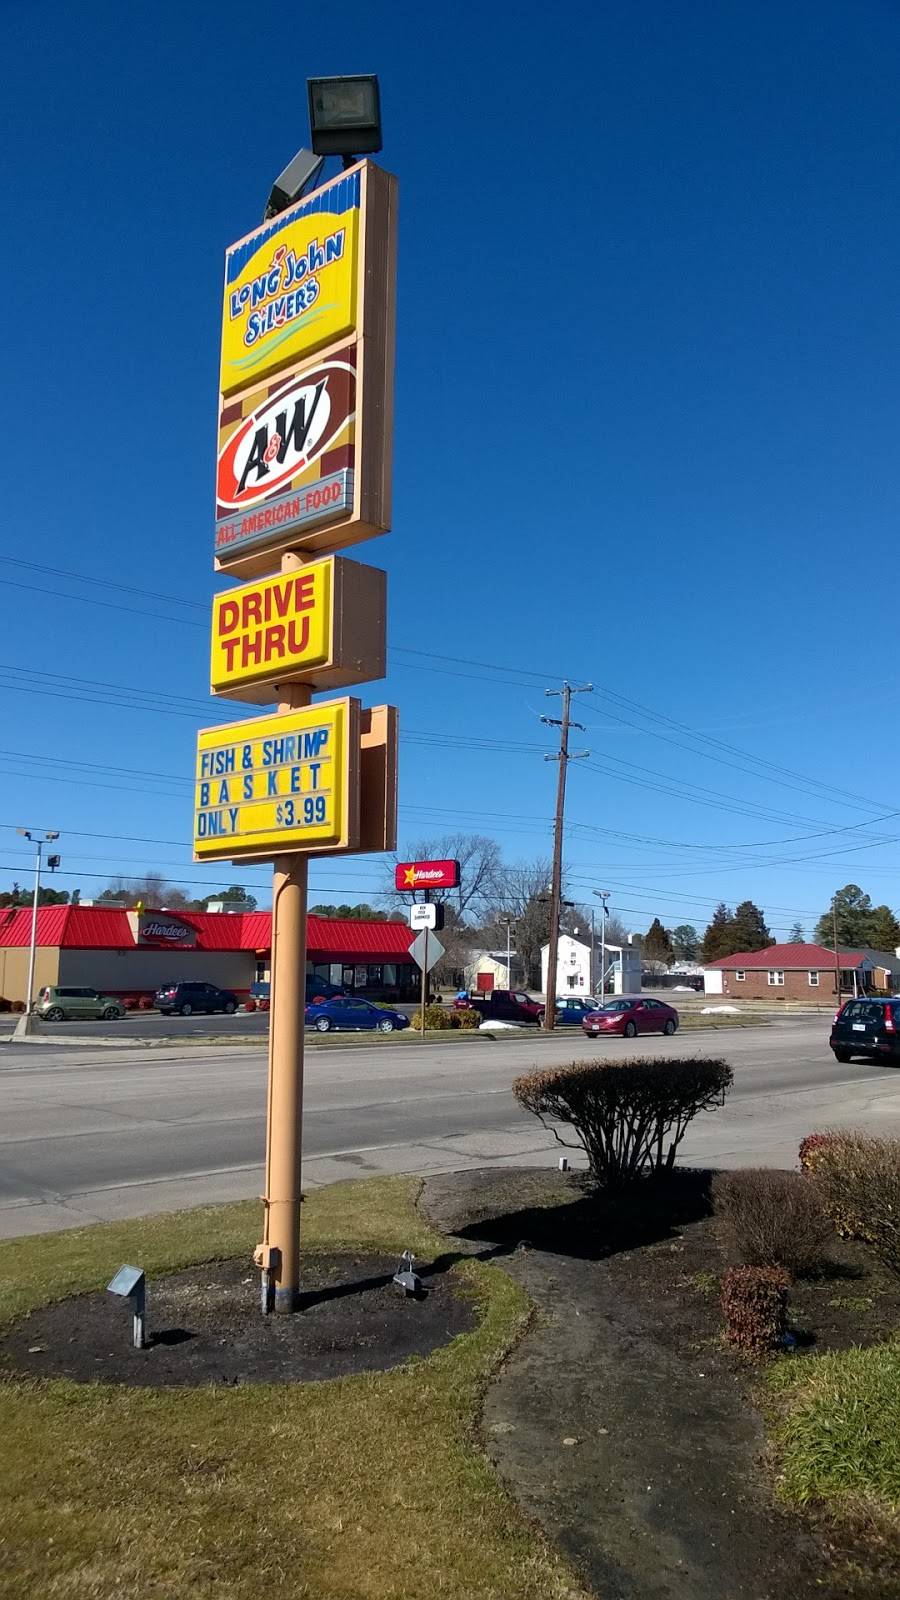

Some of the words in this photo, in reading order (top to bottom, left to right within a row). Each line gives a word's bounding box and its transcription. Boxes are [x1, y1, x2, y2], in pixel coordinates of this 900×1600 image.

[234, 375, 329, 498] A&W
[217, 523, 237, 546] ALL
[240, 497, 300, 536] AMERICAN
[305, 481, 341, 512] FOOD
[218, 573, 316, 637] DRIVE
[221, 615, 310, 673] THRU
[201, 747, 236, 777] FISH
[242, 744, 253, 769] &
[262, 729, 329, 766] SHRIMP
[197, 807, 240, 837] ONLY
[276, 796, 327, 826] $3.99
